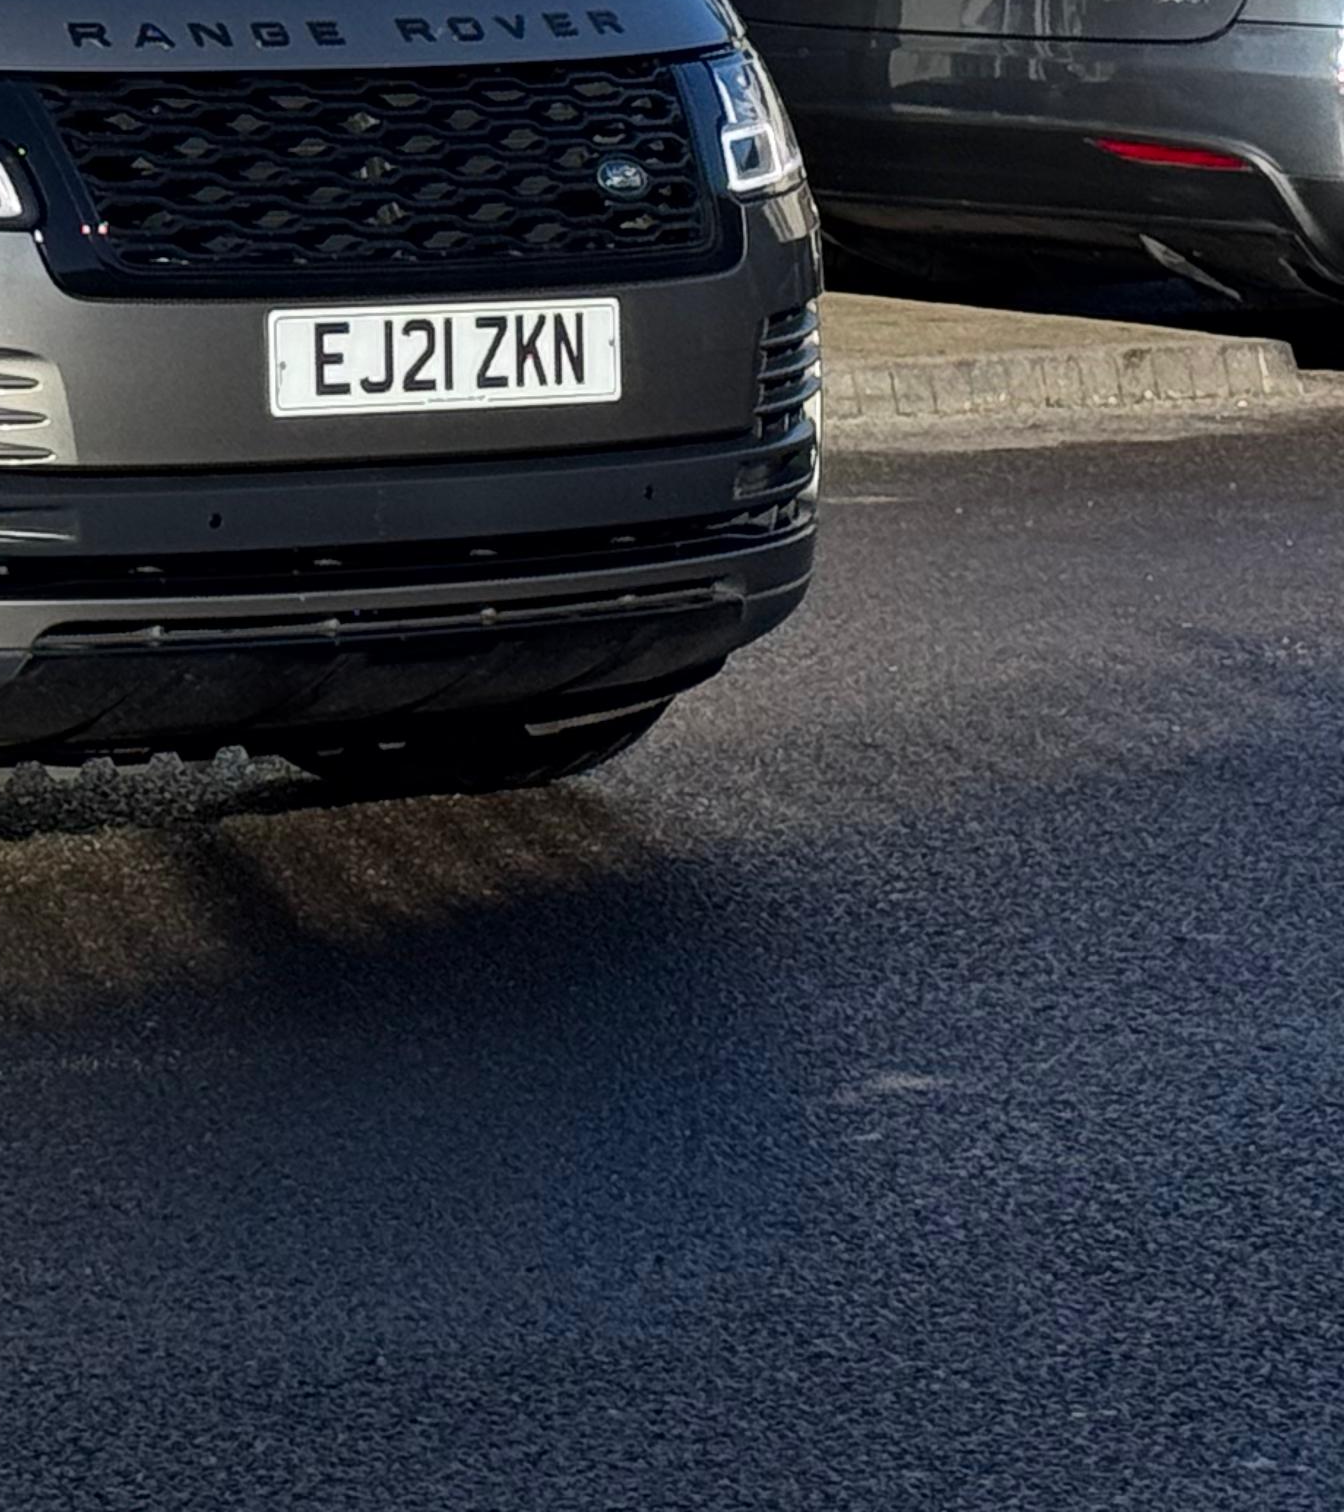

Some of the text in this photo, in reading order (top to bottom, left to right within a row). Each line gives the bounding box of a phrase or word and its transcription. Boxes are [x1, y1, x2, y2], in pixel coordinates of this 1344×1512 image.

[67, 9, 625, 49] RANGE ROVER
[314, 313, 586, 396] EJ21 ZKN
